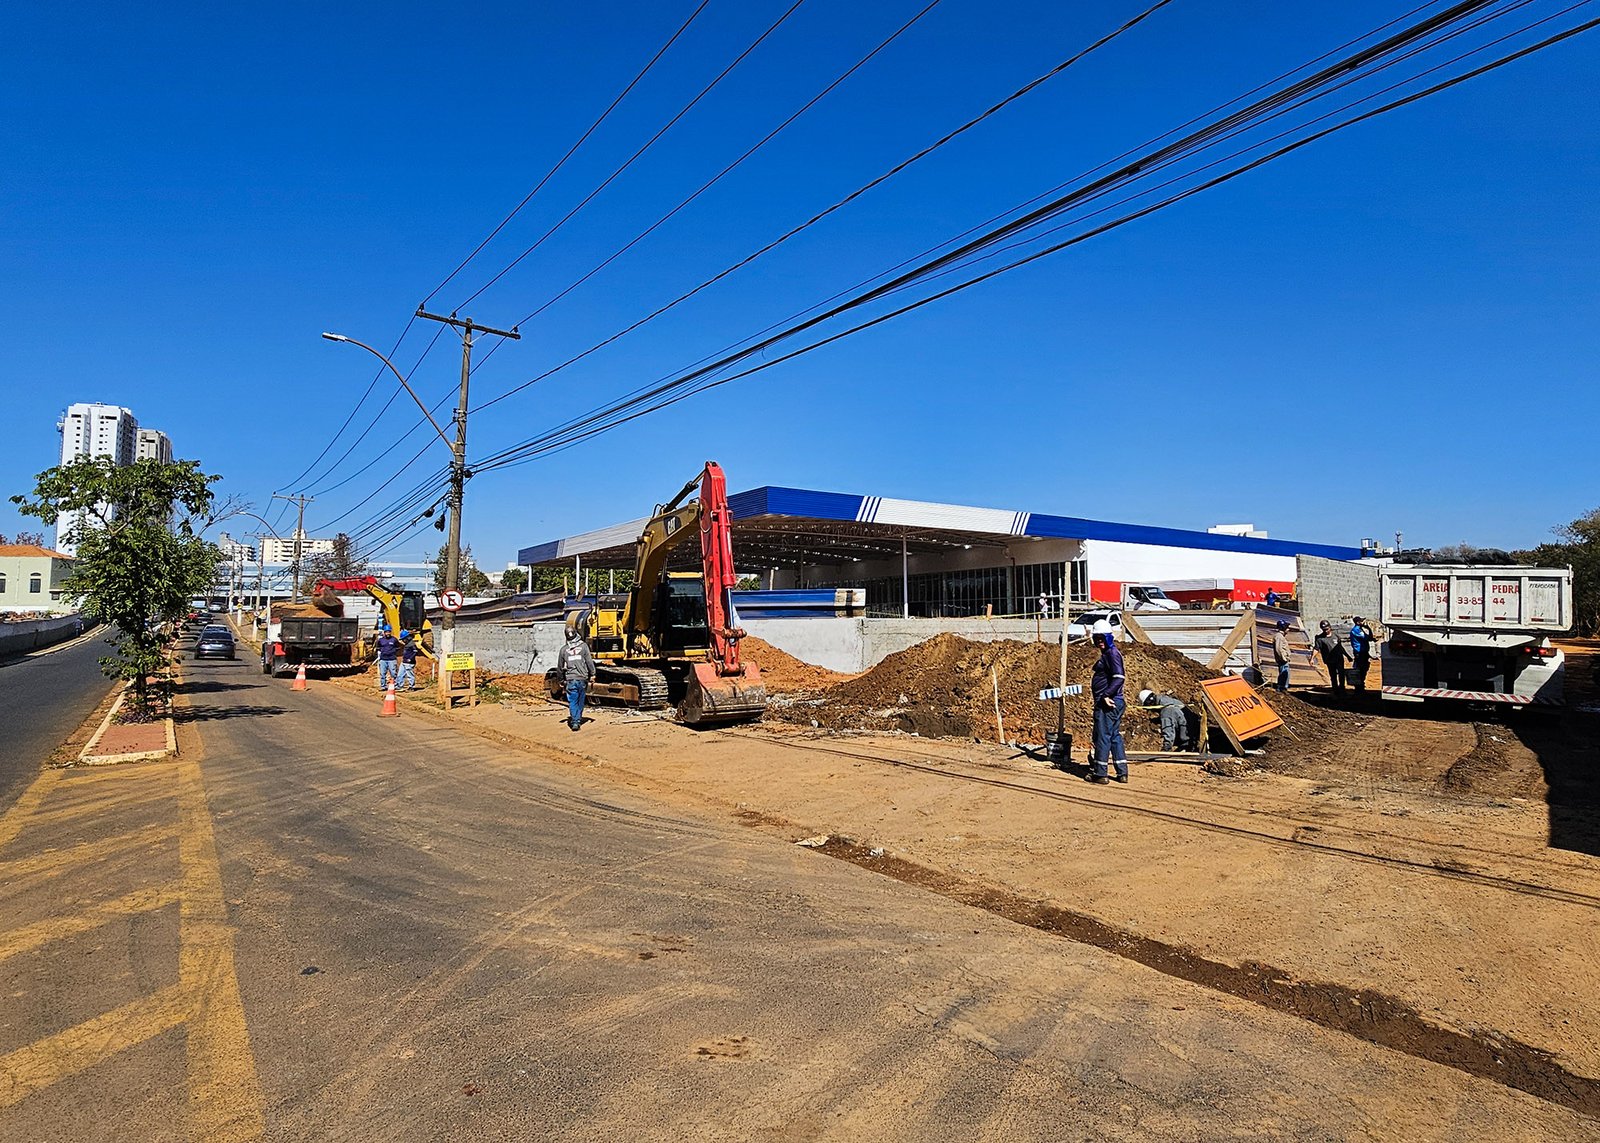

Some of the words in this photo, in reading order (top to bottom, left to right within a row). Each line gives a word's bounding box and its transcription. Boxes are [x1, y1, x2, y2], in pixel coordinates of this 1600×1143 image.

[1423, 582, 1448, 592] AREIA
[1492, 584, 1519, 594] PEDRA
[447, 594, 457, 606] E
[1436, 595, 1448, 604] 34
[1492, 597, 1506, 605] 44
[1218, 696, 1254, 716] DESVIO
